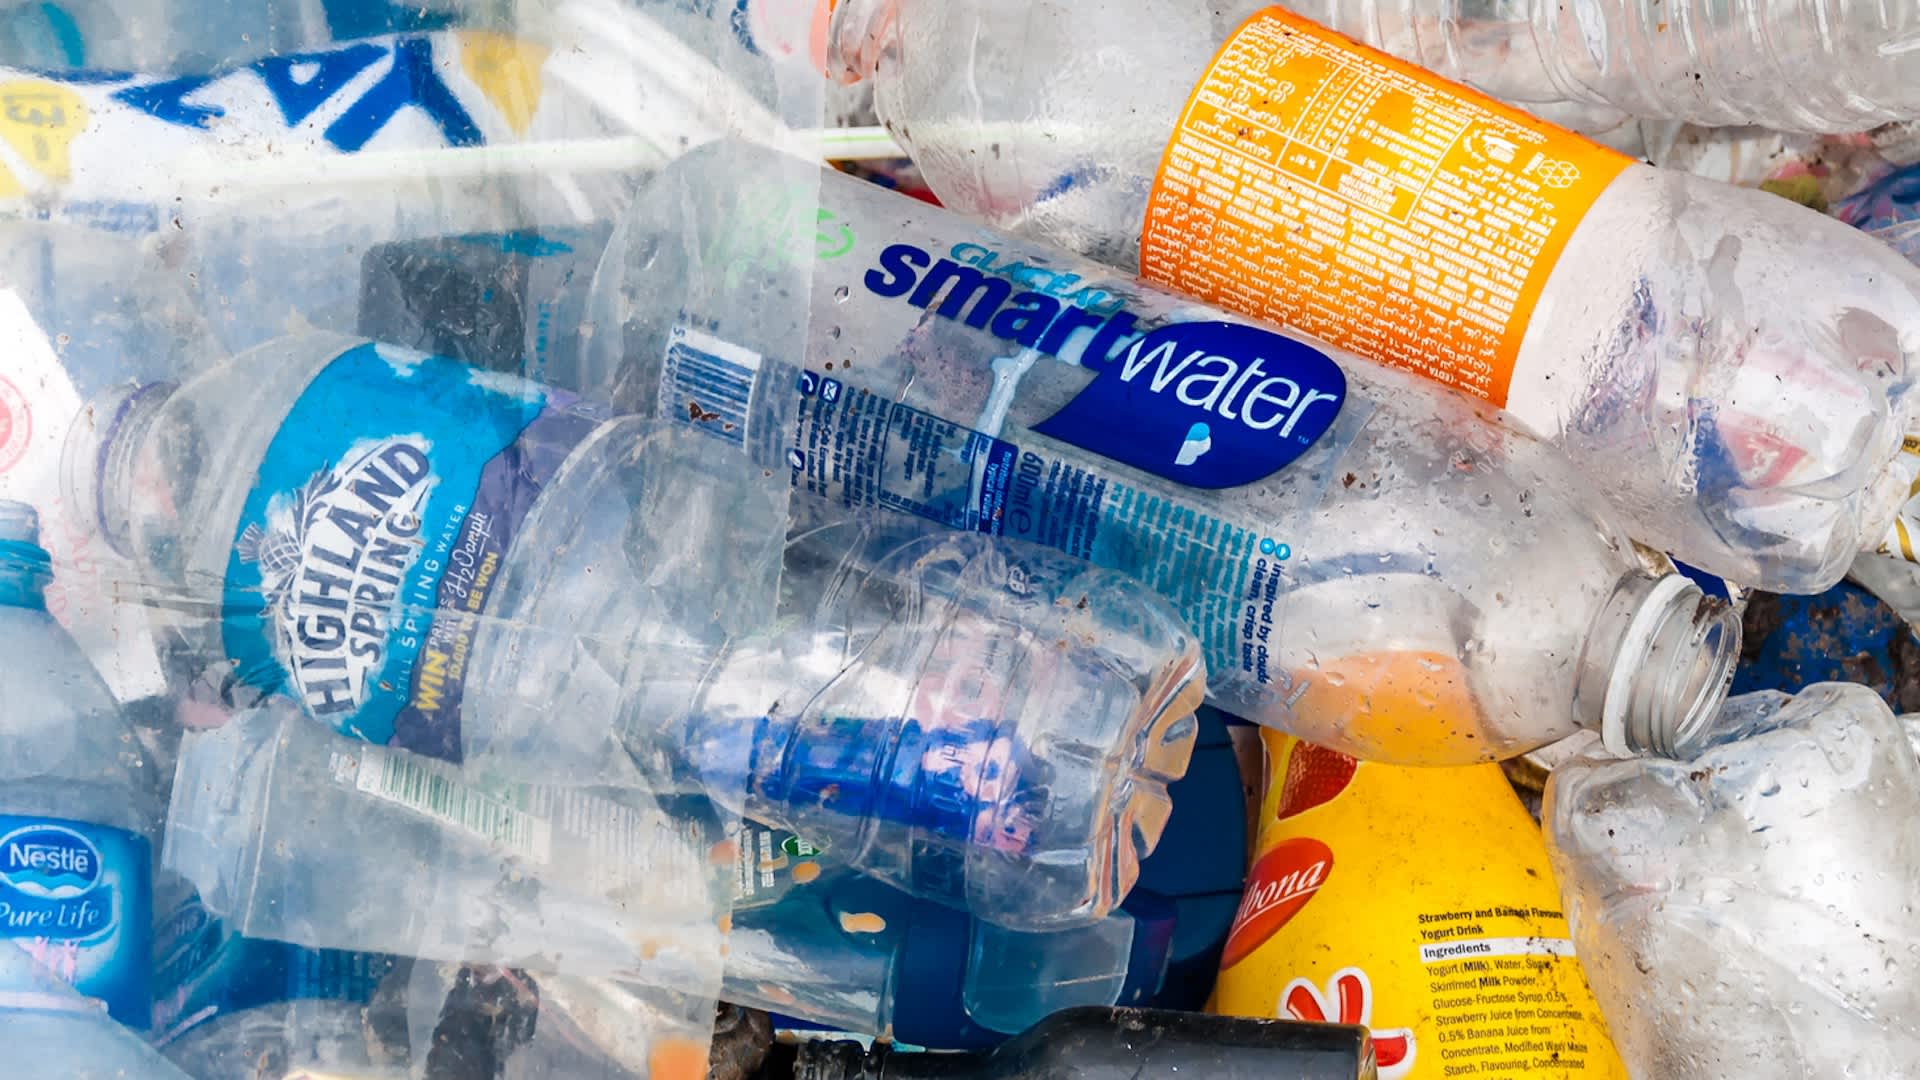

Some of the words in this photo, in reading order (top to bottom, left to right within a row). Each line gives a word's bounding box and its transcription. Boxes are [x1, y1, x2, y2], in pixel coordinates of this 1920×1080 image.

[983, 461, 999, 494] typical
[997, 450, 1010, 490] nutrition
[980, 492, 993, 521] values
[436, 503, 466, 554] WATER
[297, 442, 431, 716] HIGHLAND
[350, 511, 421, 664] SPRING
[467, 583, 484, 610] BE
[476, 551, 498, 585] WON
[1250, 556, 1267, 604] clean,
[1261, 561, 1281, 624] inspired
[401, 560, 439, 648] SPRING
[1242, 604, 1257, 641] crisp
[1256, 624, 1270, 643] by
[1242, 642, 1253, 673] taste
[1258, 644, 1268, 685] clouds
[396, 657, 412, 702] STILL
[417, 650, 450, 712] WIN
[0, 901, 52, 928] Pure
[57, 900, 100, 929] Life
[1419, 910, 1472, 924] Strawberry
[1475, 909, 1493, 918] and
[1496, 907, 1530, 919] Banana
[1420, 929, 1455, 940] Yogurt
[1457, 925, 1484, 936] Drink
[1424, 943, 1491, 958] Ingredients
[1427, 964, 1460, 977] Yogurt
[1461, 962, 1490, 974] (Milk),
[1494, 960, 1525, 969] Water,
[1431, 981, 1476, 993] Skimmed
[1479, 978, 1500, 989] Milk
[1503, 977, 1538, 986] Powder,
[1433, 994, 1516, 1009] Glucose-Fructose
[1518, 993, 1546, 1003] Syrup,
[1436, 1012, 1487, 1026] Strawberry
[1490, 1012, 1513, 1021] Juice
[1515, 1009, 1535, 1019] from
[1438, 1031, 1465, 1043] 0.5%
[1467, 1028, 1504, 1038] Banana
[1506, 1026, 1529, 1036] Juice
[1531, 1024, 1550, 1034] from
[1441, 1045, 1503, 1060] Concentrate,
[1505, 1042, 1543, 1053] Modified
[1444, 1062, 1479, 1076] Starch,
[1481, 1057, 1530, 1072] Flavouring,
[1533, 1057, 1585, 1069] Concentrated
